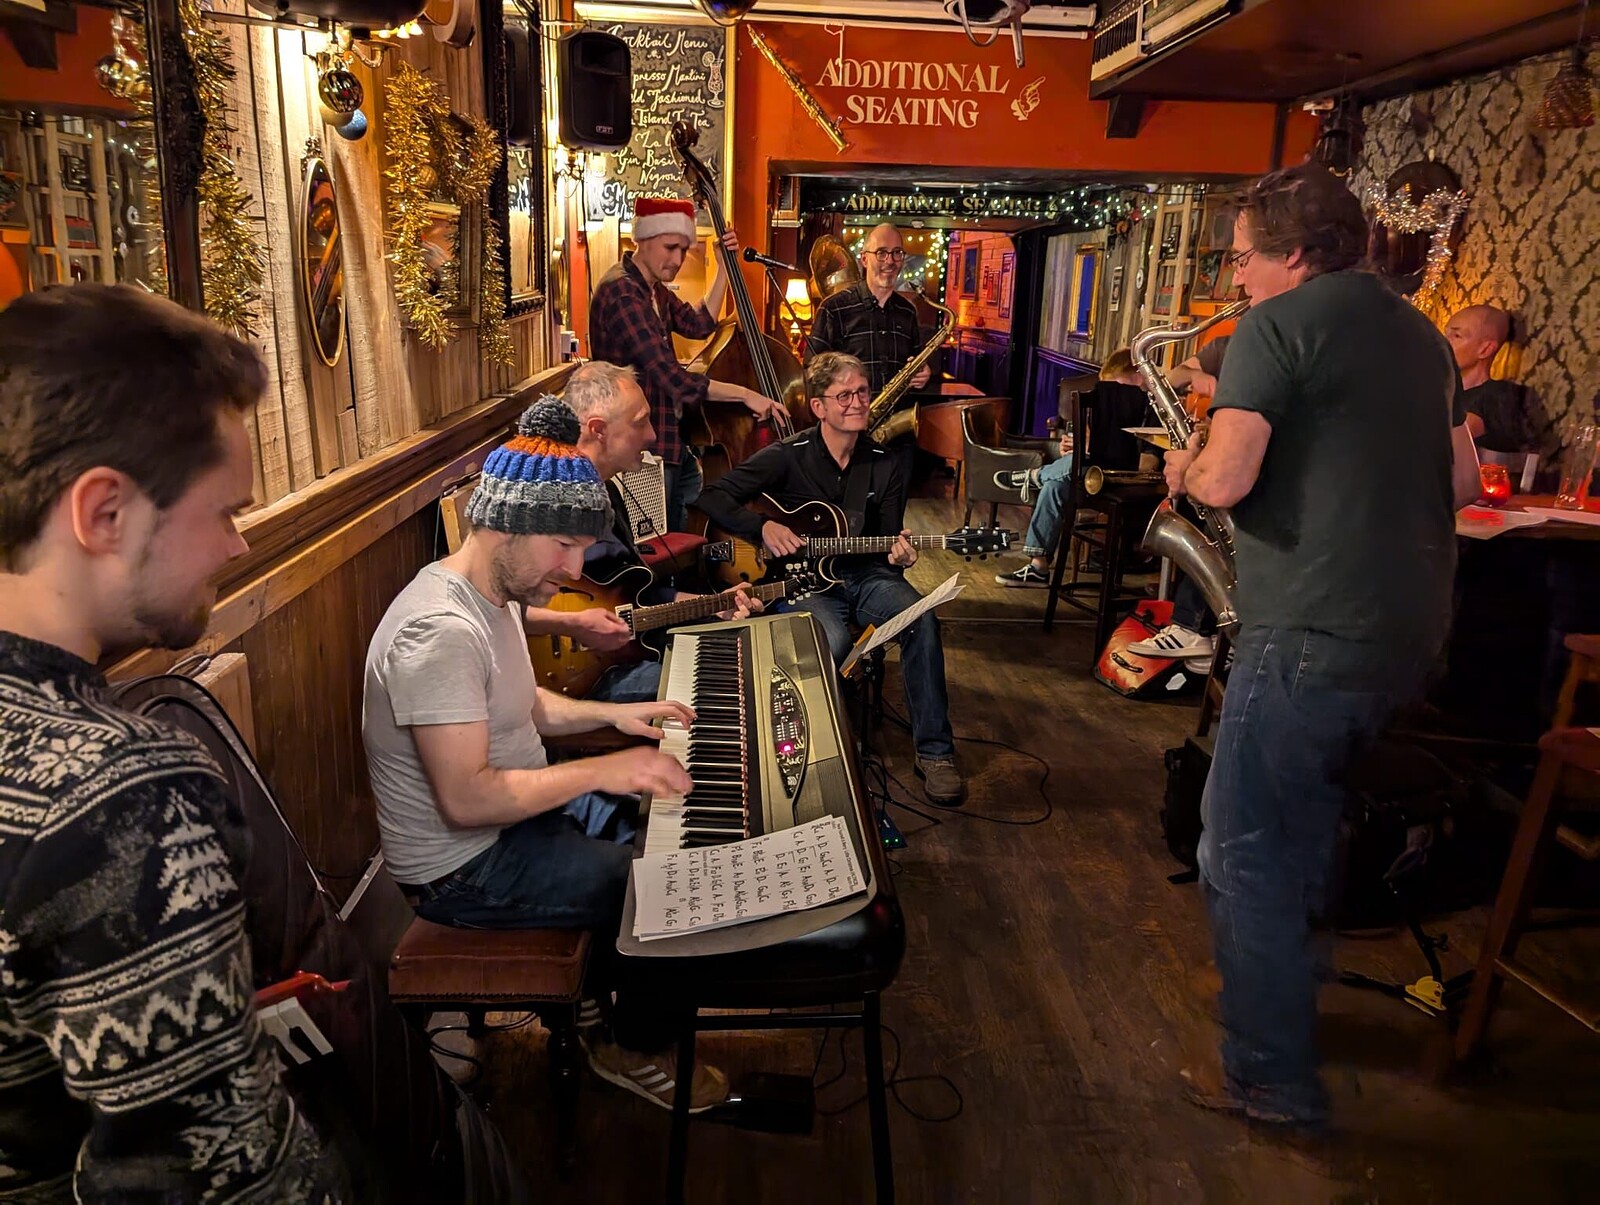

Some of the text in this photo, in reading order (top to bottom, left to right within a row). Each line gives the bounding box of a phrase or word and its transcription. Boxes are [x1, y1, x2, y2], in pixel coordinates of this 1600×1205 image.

[667, 30, 708, 56] Menu
[632, 64, 706, 92] presso Martini
[816, 58, 1010, 94] ADDITIONAL
[631, 88, 705, 112] ld Fashioned
[846, 95, 979, 128] SEATING
[690, 111, 711, 130] Tea
[611, 147, 640, 174] Gin
[642, 149, 676, 169] Basi
[845, 193, 952, 214] ADDITIONAL
[962, 196, 1040, 216] SEATING
